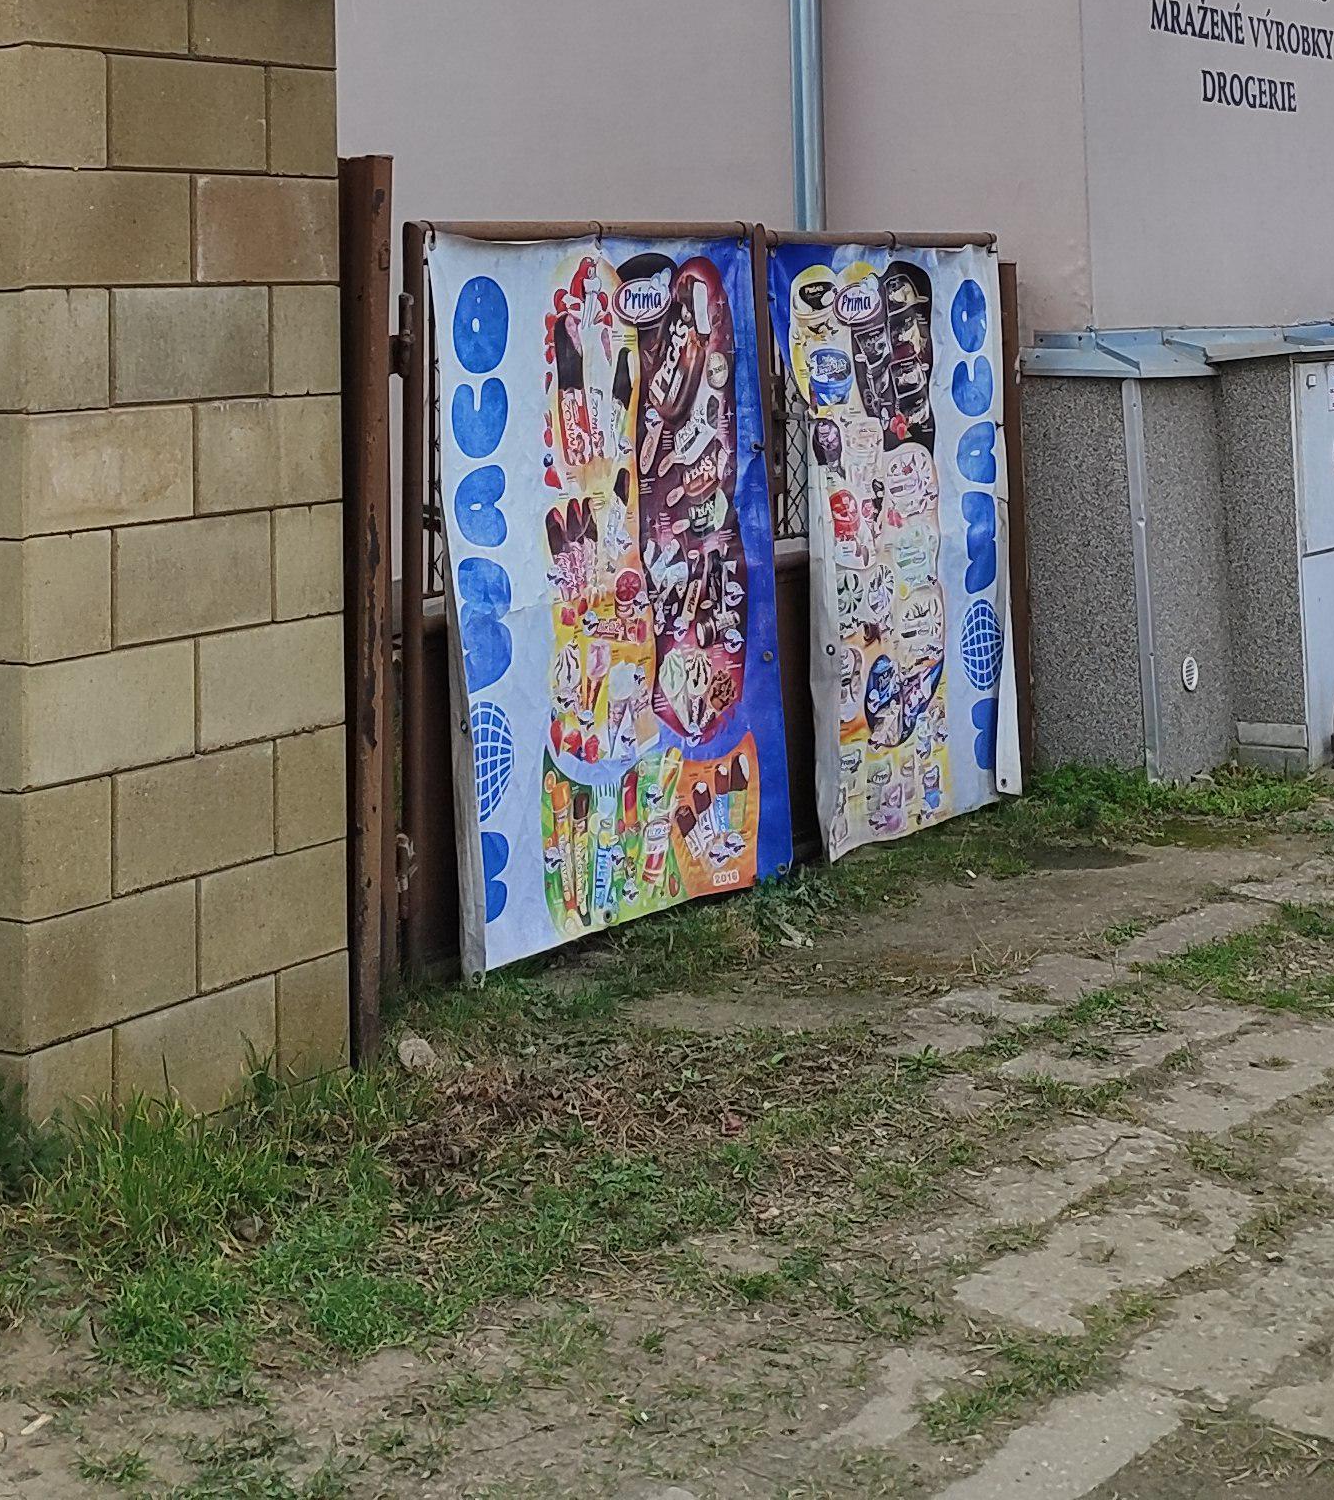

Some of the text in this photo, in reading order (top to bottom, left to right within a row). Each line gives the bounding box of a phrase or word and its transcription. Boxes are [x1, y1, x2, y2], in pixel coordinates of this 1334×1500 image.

[1248, 8, 1334, 61] VÝROBKY
[1201, 69, 1298, 113] DROGERIE
[623, 287, 662, 311] Prima
[841, 293, 872, 312] Prima
